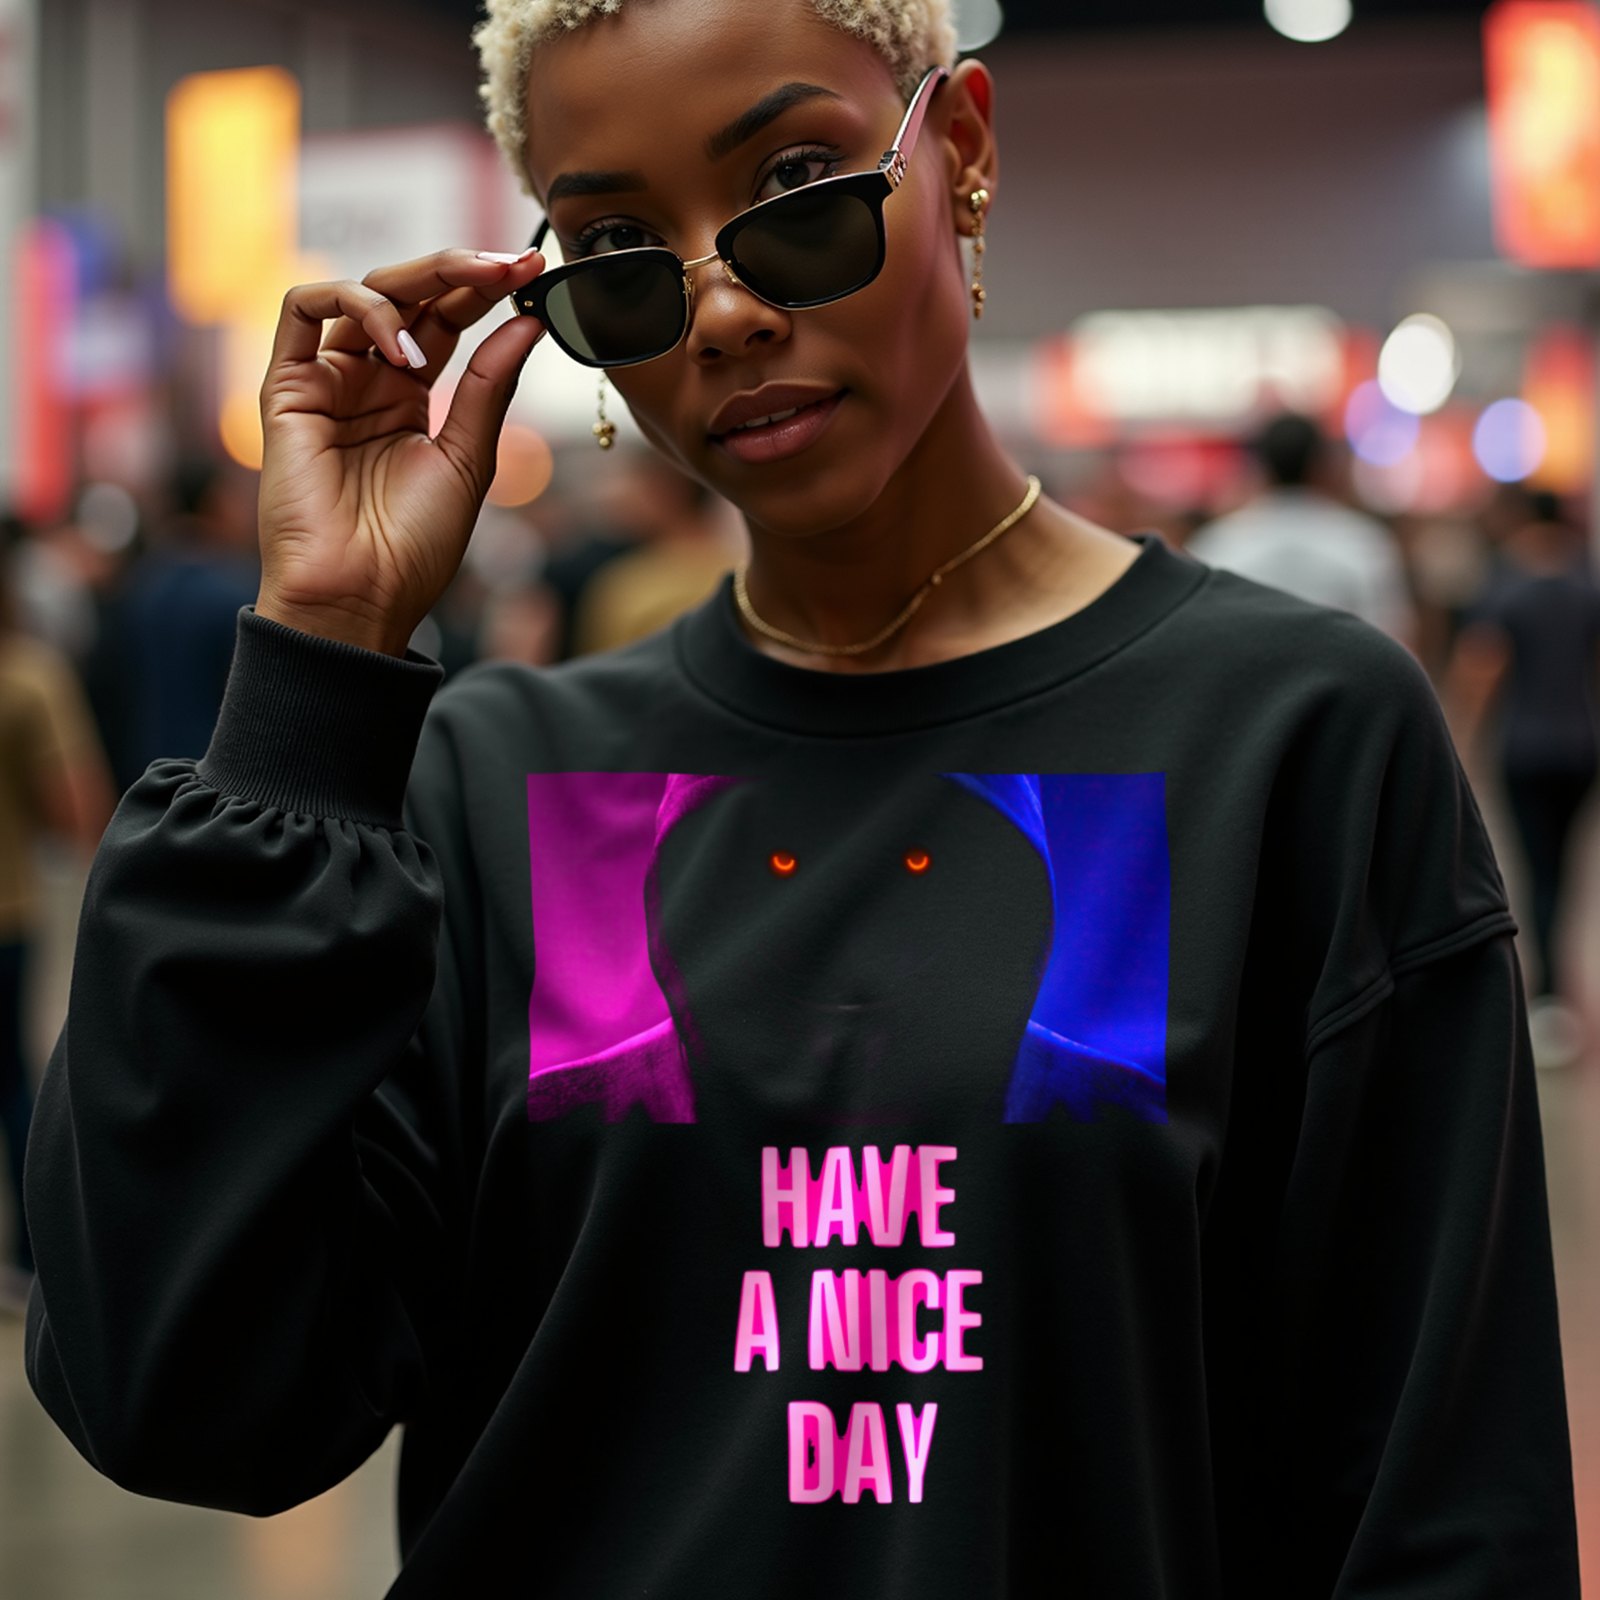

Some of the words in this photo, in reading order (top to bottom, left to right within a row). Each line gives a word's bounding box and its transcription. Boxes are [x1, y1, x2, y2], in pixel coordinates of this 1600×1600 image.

[762, 1144, 957, 1248] HAVE
[734, 1270, 780, 1373] A
[808, 1268, 984, 1373] NICE
[788, 1401, 938, 1504] DAY
